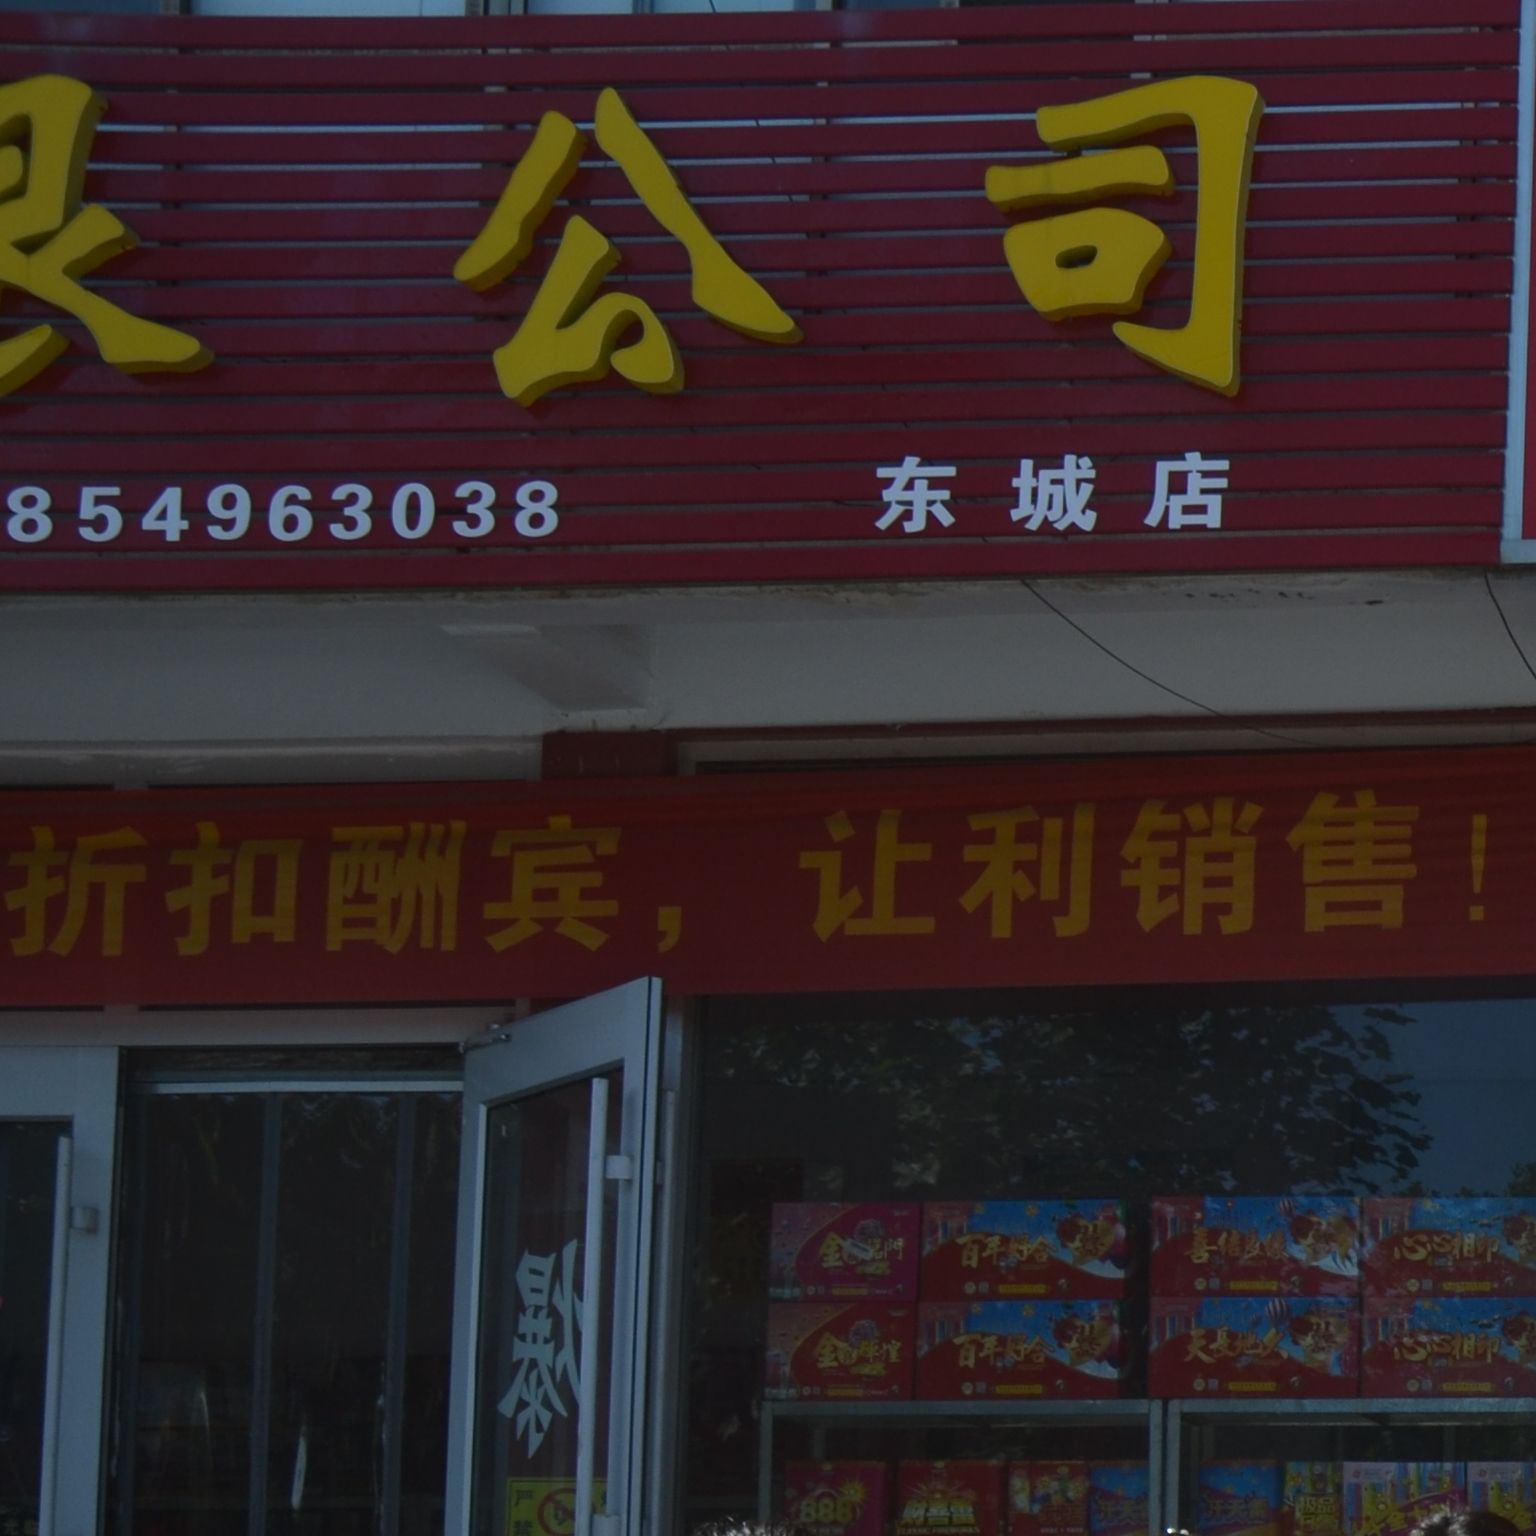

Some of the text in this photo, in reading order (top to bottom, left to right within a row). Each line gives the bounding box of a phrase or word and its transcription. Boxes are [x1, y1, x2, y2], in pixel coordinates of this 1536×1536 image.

[6, 479, 560, 543] 854963038
[875, 452, 1231, 533] 东城店
